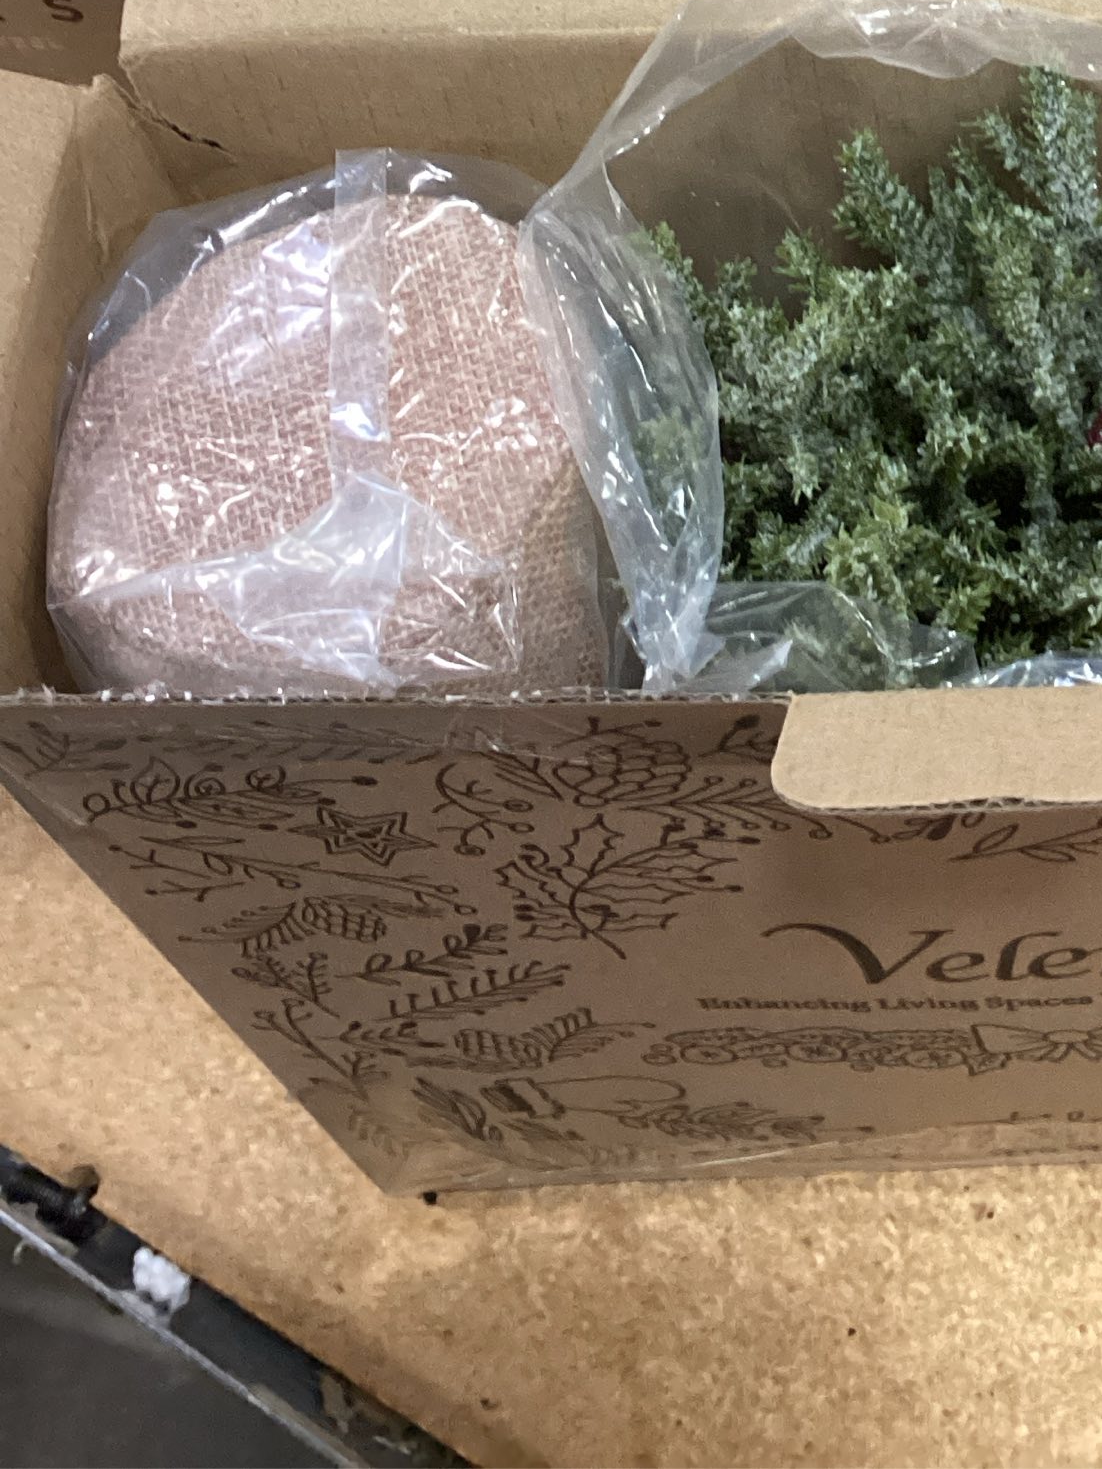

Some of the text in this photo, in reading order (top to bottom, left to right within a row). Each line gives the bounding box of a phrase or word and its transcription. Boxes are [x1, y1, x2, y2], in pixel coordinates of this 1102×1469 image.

[696, 997, 872, 1012] Enhancing
[876, 997, 980, 1011] Living
[985, 995, 1093, 1011] Spaces
